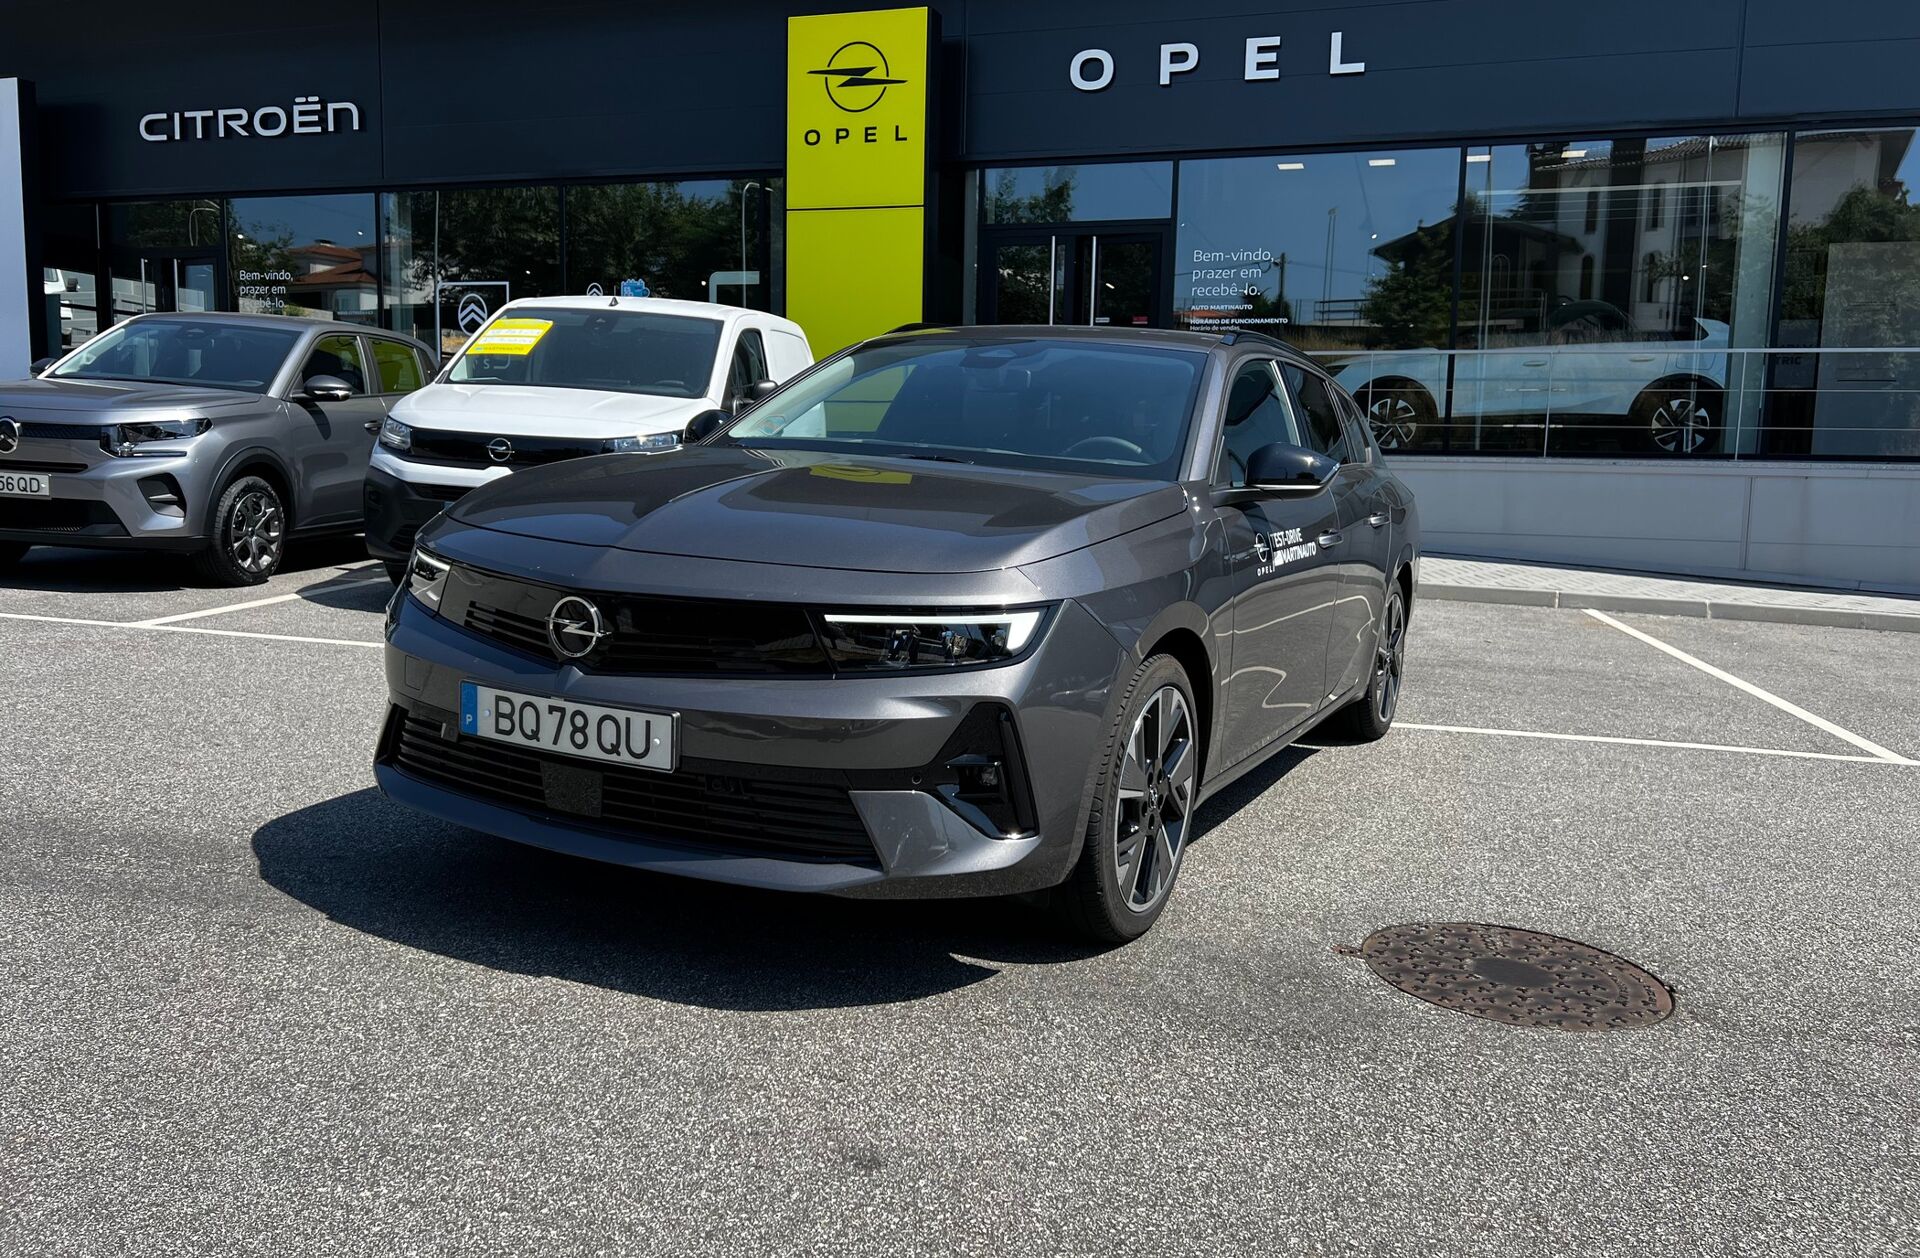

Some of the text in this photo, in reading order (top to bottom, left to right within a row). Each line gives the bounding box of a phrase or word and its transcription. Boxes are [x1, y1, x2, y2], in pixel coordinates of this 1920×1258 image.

[1070, 31, 1365, 90] OPEL
[139, 95, 359, 141] CITROËN
[804, 125, 907, 145] OPEL
[1193, 247, 1274, 262] Bem-vindo,
[239, 269, 293, 281] Bem-vindo,
[1192, 268, 1262, 282] prazer em
[240, 284, 286, 296] prazer em
[1191, 282, 1261, 296] recebê-lo.
[1270, 527, 1303, 549] TEST-DRIVE
[1257, 566, 1272, 577] OPEL
[465, 713, 473, 725] P
